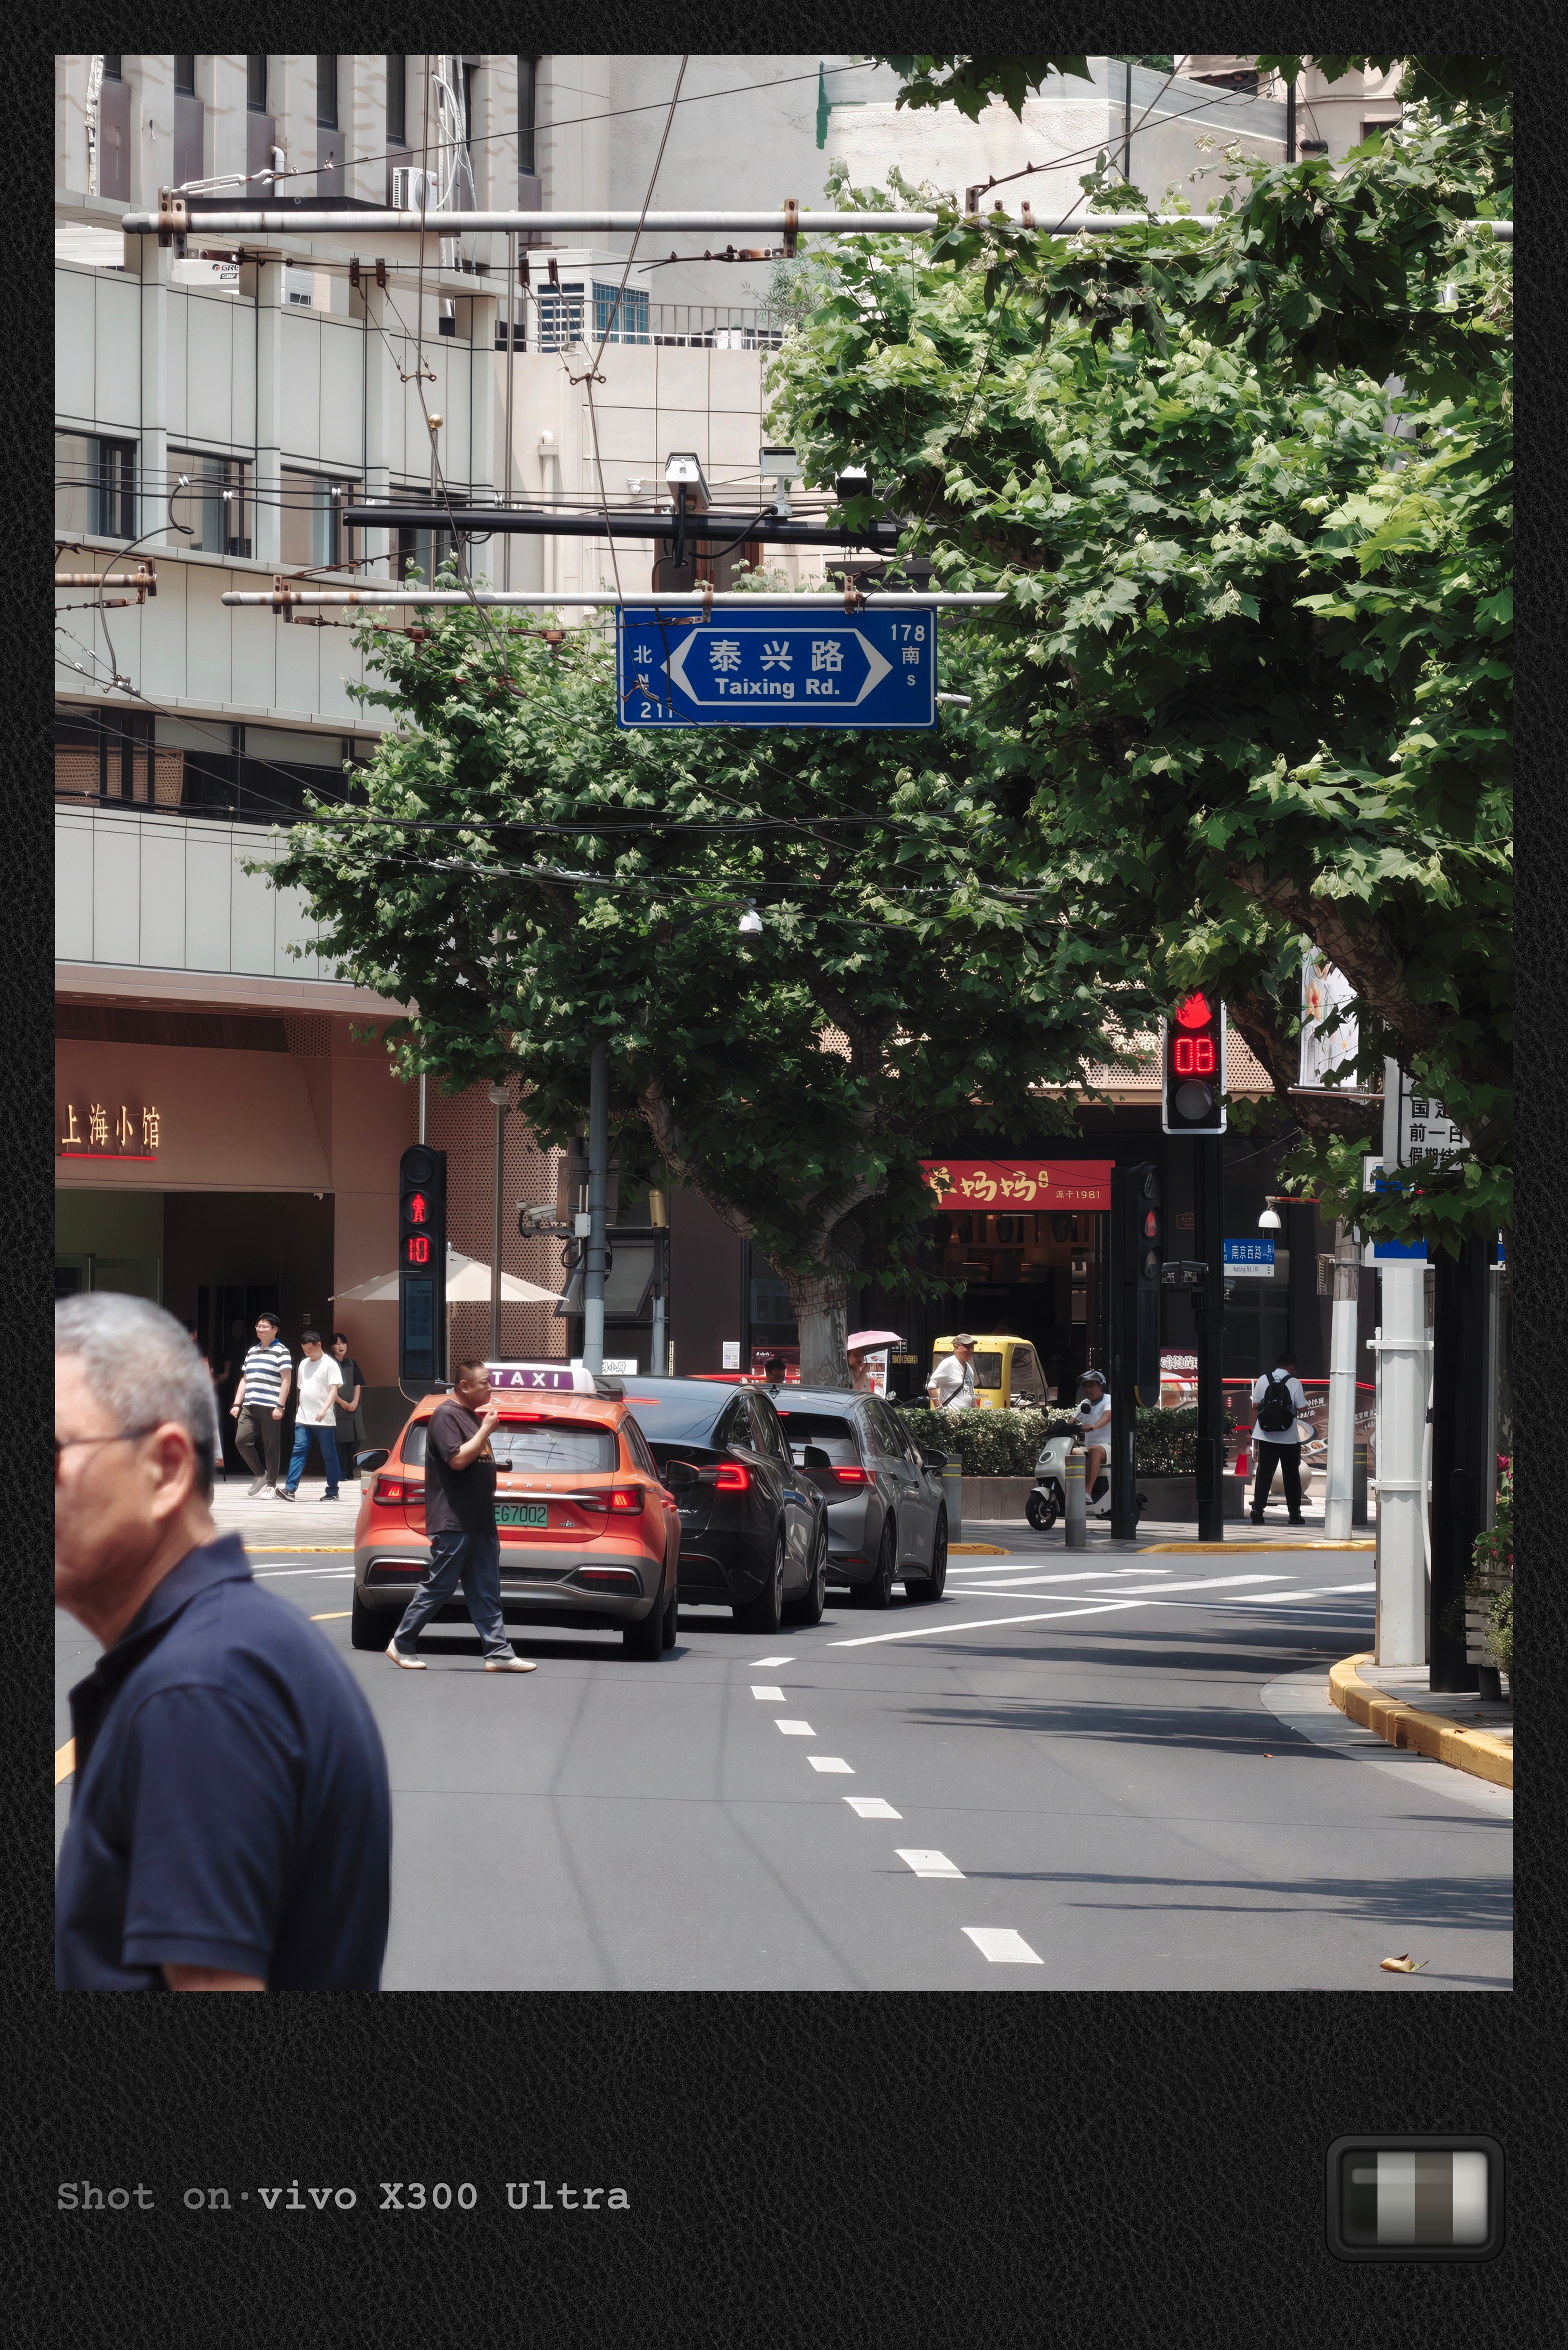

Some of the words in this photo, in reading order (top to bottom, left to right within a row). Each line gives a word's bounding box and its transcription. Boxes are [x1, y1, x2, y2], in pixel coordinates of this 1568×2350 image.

[891, 624, 925, 642] 178
[634, 645, 653, 663] 北
[709, 639, 844, 672] 泰兴路
[901, 645, 920, 664] 南
[715, 678, 794, 699] Taixing
[806, 679, 840, 695] Rd.
[907, 674, 916, 686] S
[1176, 1038, 1214, 1072] 08
[62, 1103, 160, 1149] 上海小馆
[1409, 1123, 1463, 1144] 前一日
[409, 1237, 429, 1262] 10
[492, 1371, 559, 1387] TAXI
[495, 1505, 546, 1523] EG7002
